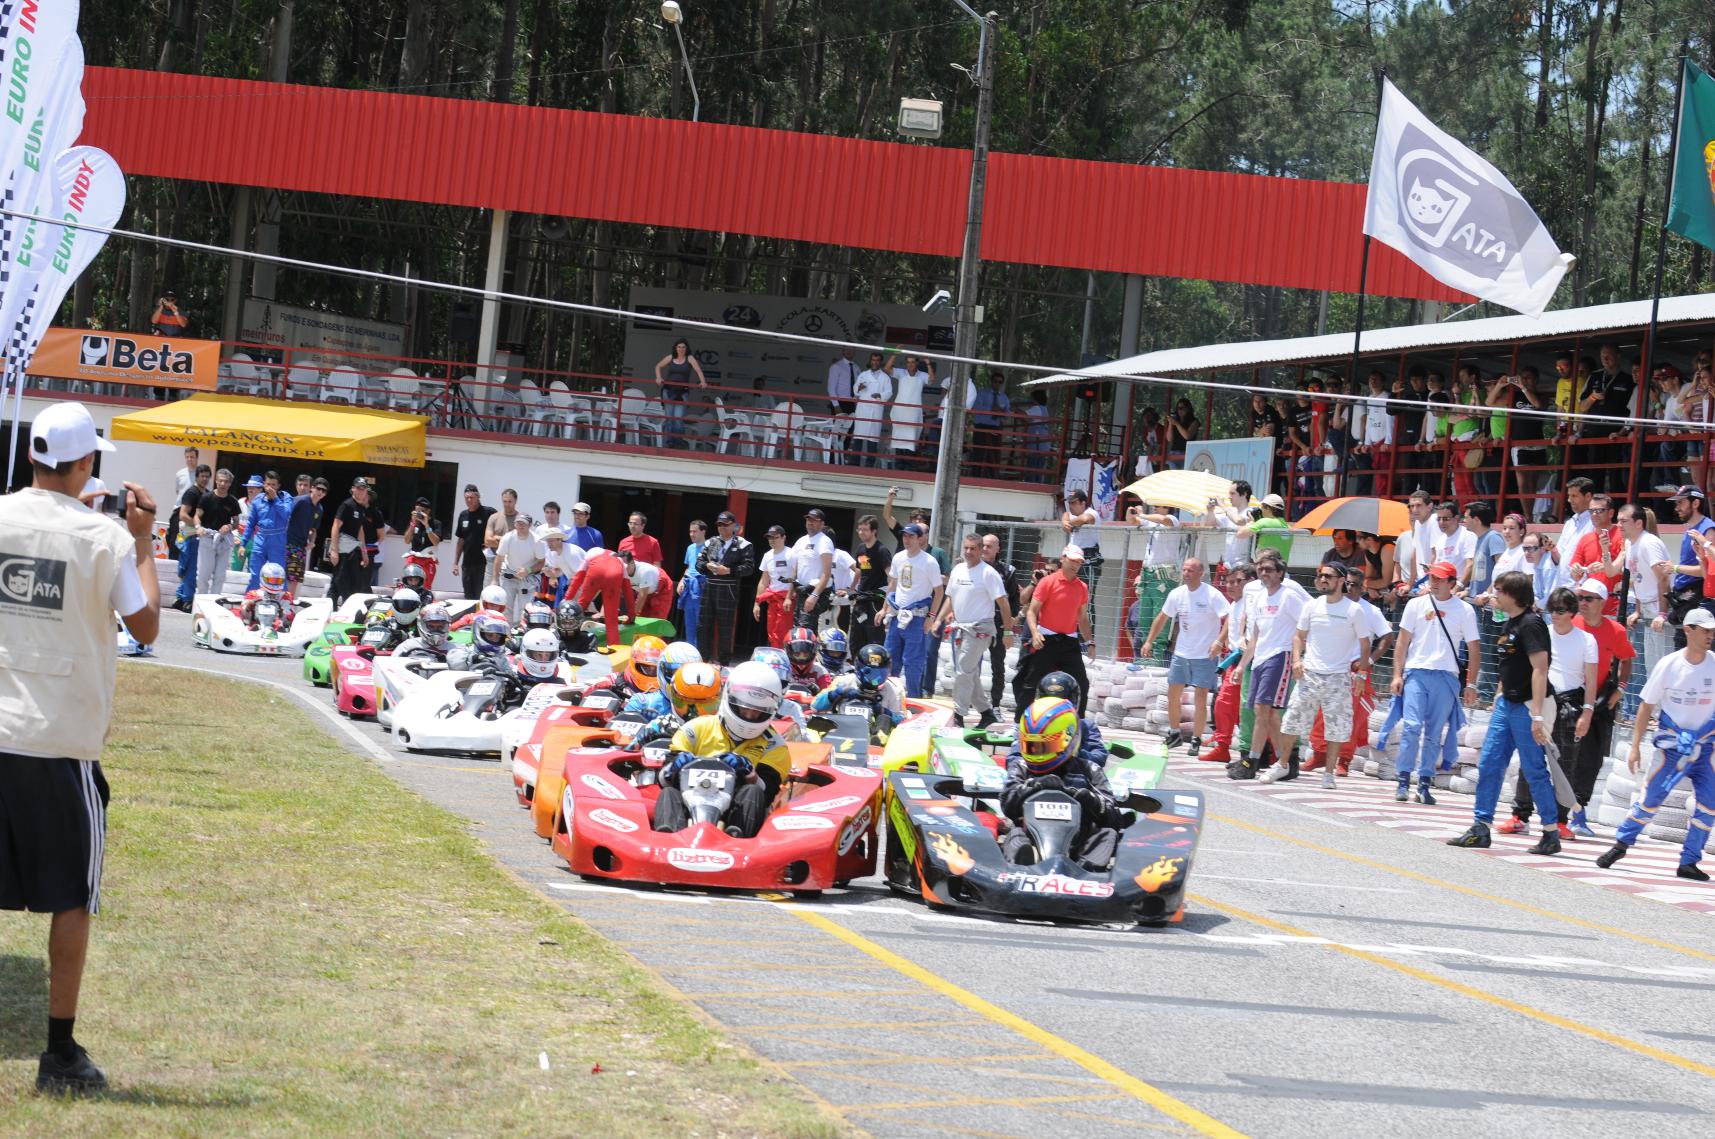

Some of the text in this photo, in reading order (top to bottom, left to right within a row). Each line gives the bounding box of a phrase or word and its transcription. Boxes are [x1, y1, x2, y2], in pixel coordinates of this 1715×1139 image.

[6, 0, 38, 125] EURO IN
[52, 158, 95, 275] EURO INDY
[729, 307, 751, 321] 24
[111, 337, 194, 375] Beta
[152, 434, 325, 458] www.pestronix.pt
[695, 770, 720, 779] 74
[1021, 876, 1115, 897] RACES
